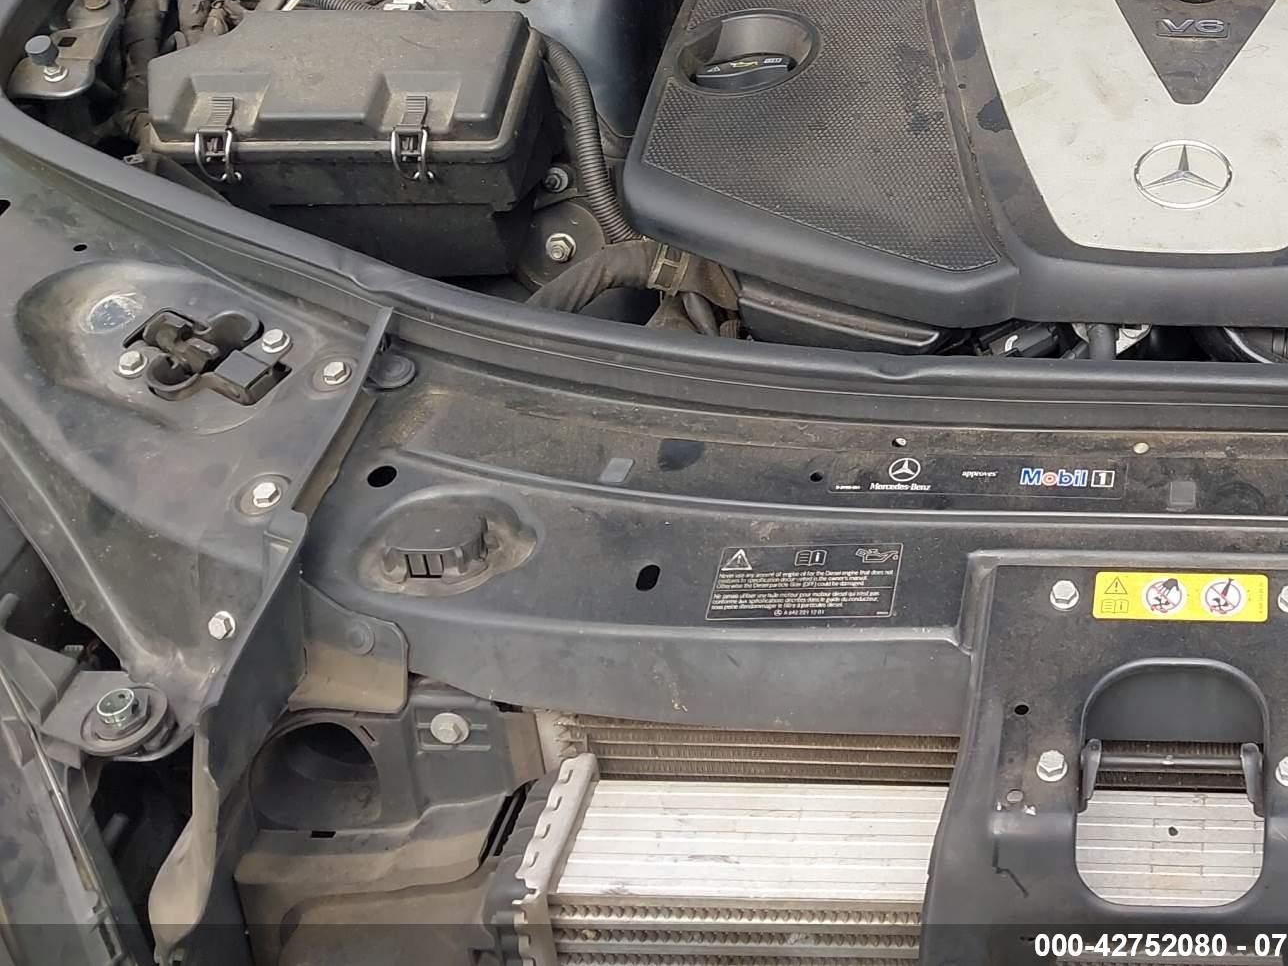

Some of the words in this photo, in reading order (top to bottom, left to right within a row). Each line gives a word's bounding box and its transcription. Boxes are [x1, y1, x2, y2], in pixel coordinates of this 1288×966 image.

[1161, 18, 1225, 33] V6
[869, 482, 931, 491] Mercedes-Benz
[1020, 468, 1088, 487] Mobil
